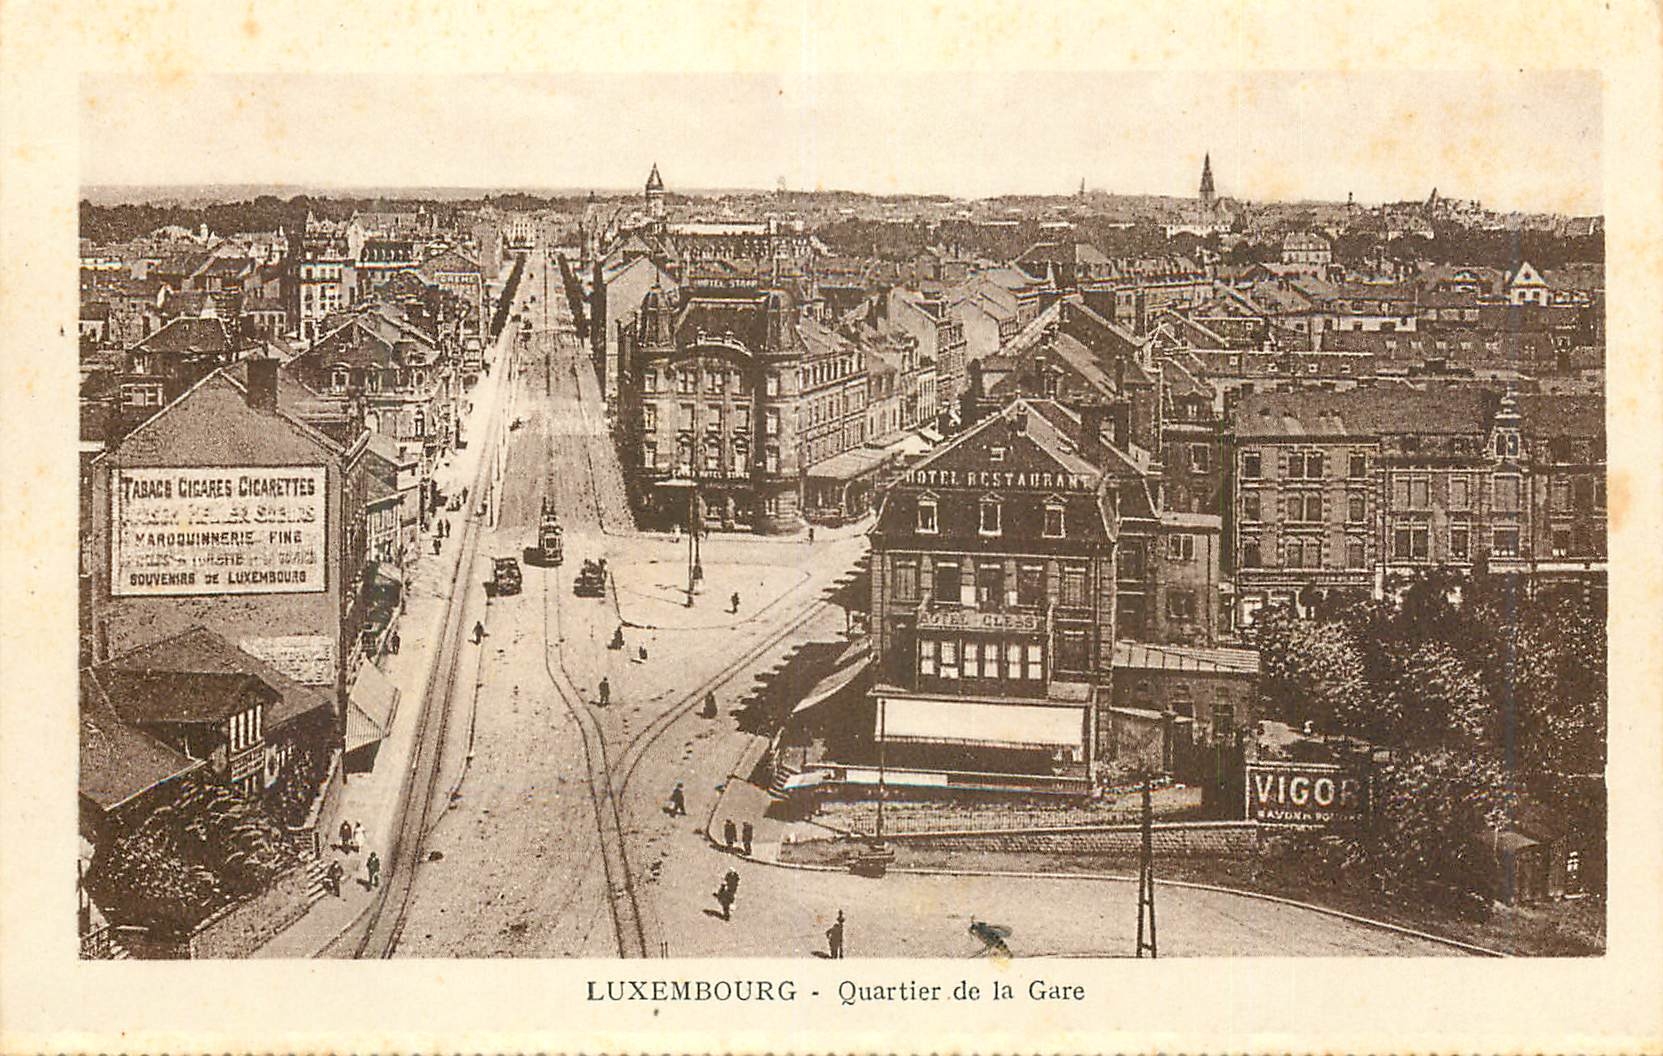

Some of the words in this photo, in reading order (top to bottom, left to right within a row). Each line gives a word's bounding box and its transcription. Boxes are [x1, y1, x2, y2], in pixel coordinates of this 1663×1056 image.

[906, 469, 957, 486] HOTEL
[967, 471, 1091, 489] RESTAURANT
[121, 476, 173, 502] TABACS
[178, 477, 233, 499] CIGARES
[238, 475, 316, 498] CIGARETTES
[269, 530, 303, 545] FINE
[129, 571, 196, 587] SOUVENIRS
[204, 572, 220, 585] DE
[228, 570, 307, 585] LUXEMBOURG
